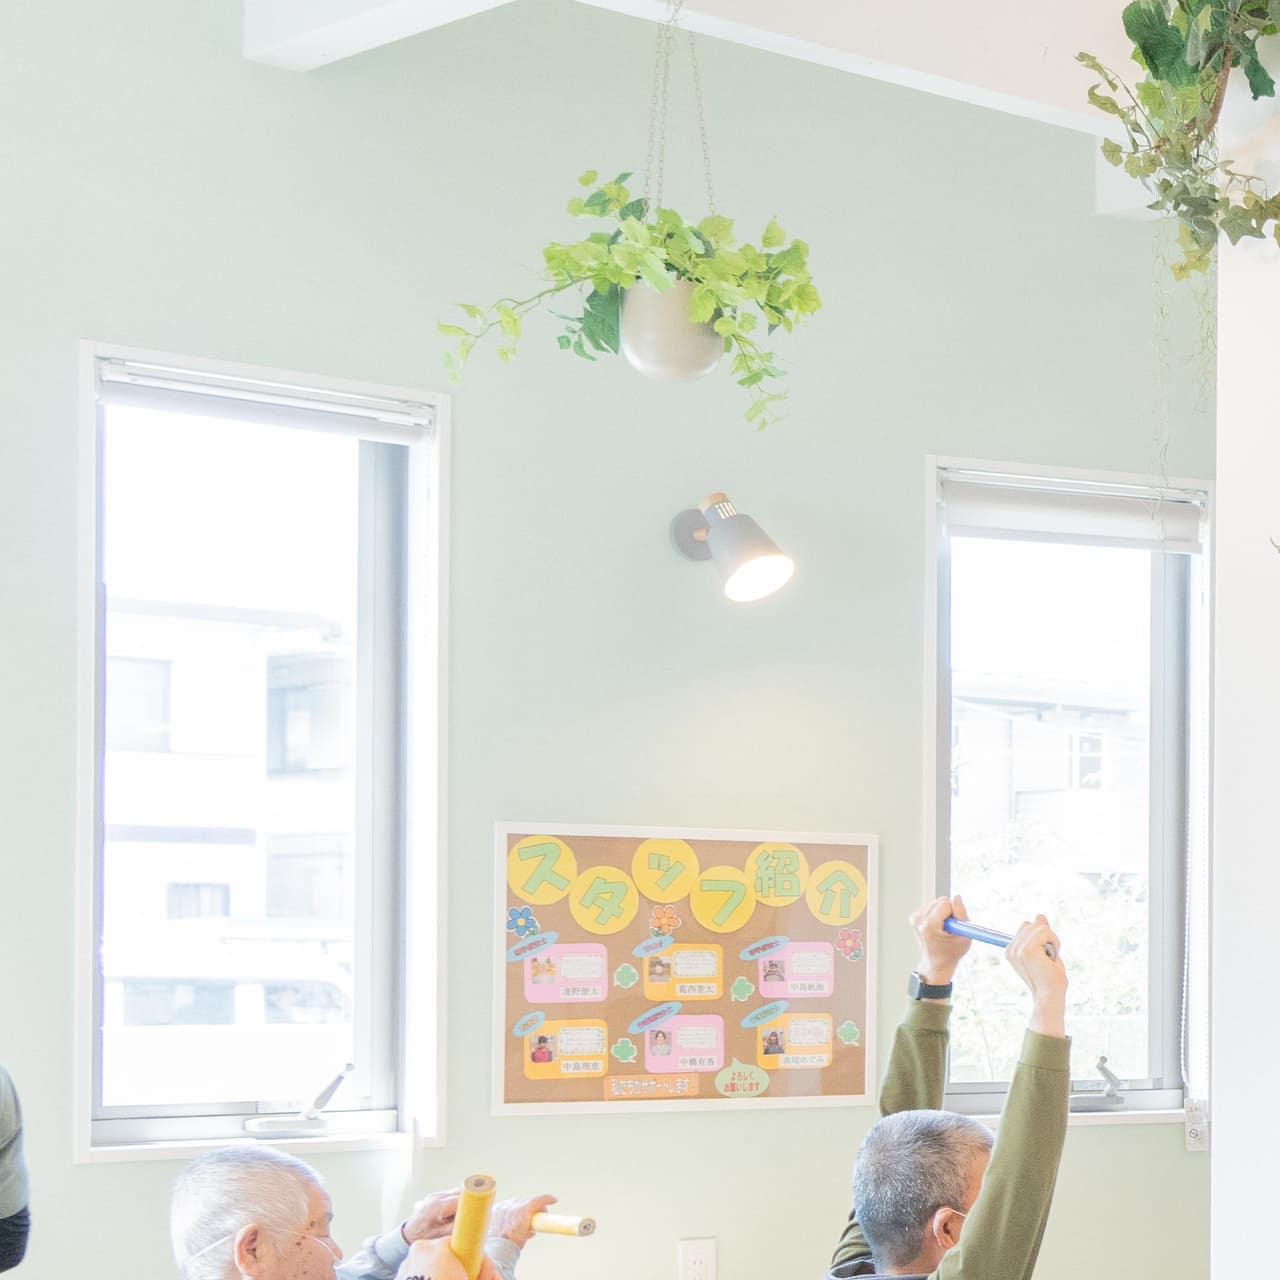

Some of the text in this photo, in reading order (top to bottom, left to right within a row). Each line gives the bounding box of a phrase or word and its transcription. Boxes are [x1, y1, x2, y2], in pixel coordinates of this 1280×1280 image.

[517, 842, 860, 926] スタッフ紹介
[730, 1071, 754, 1082] よろしく
[724, 1082, 760, 1094] お願いします
